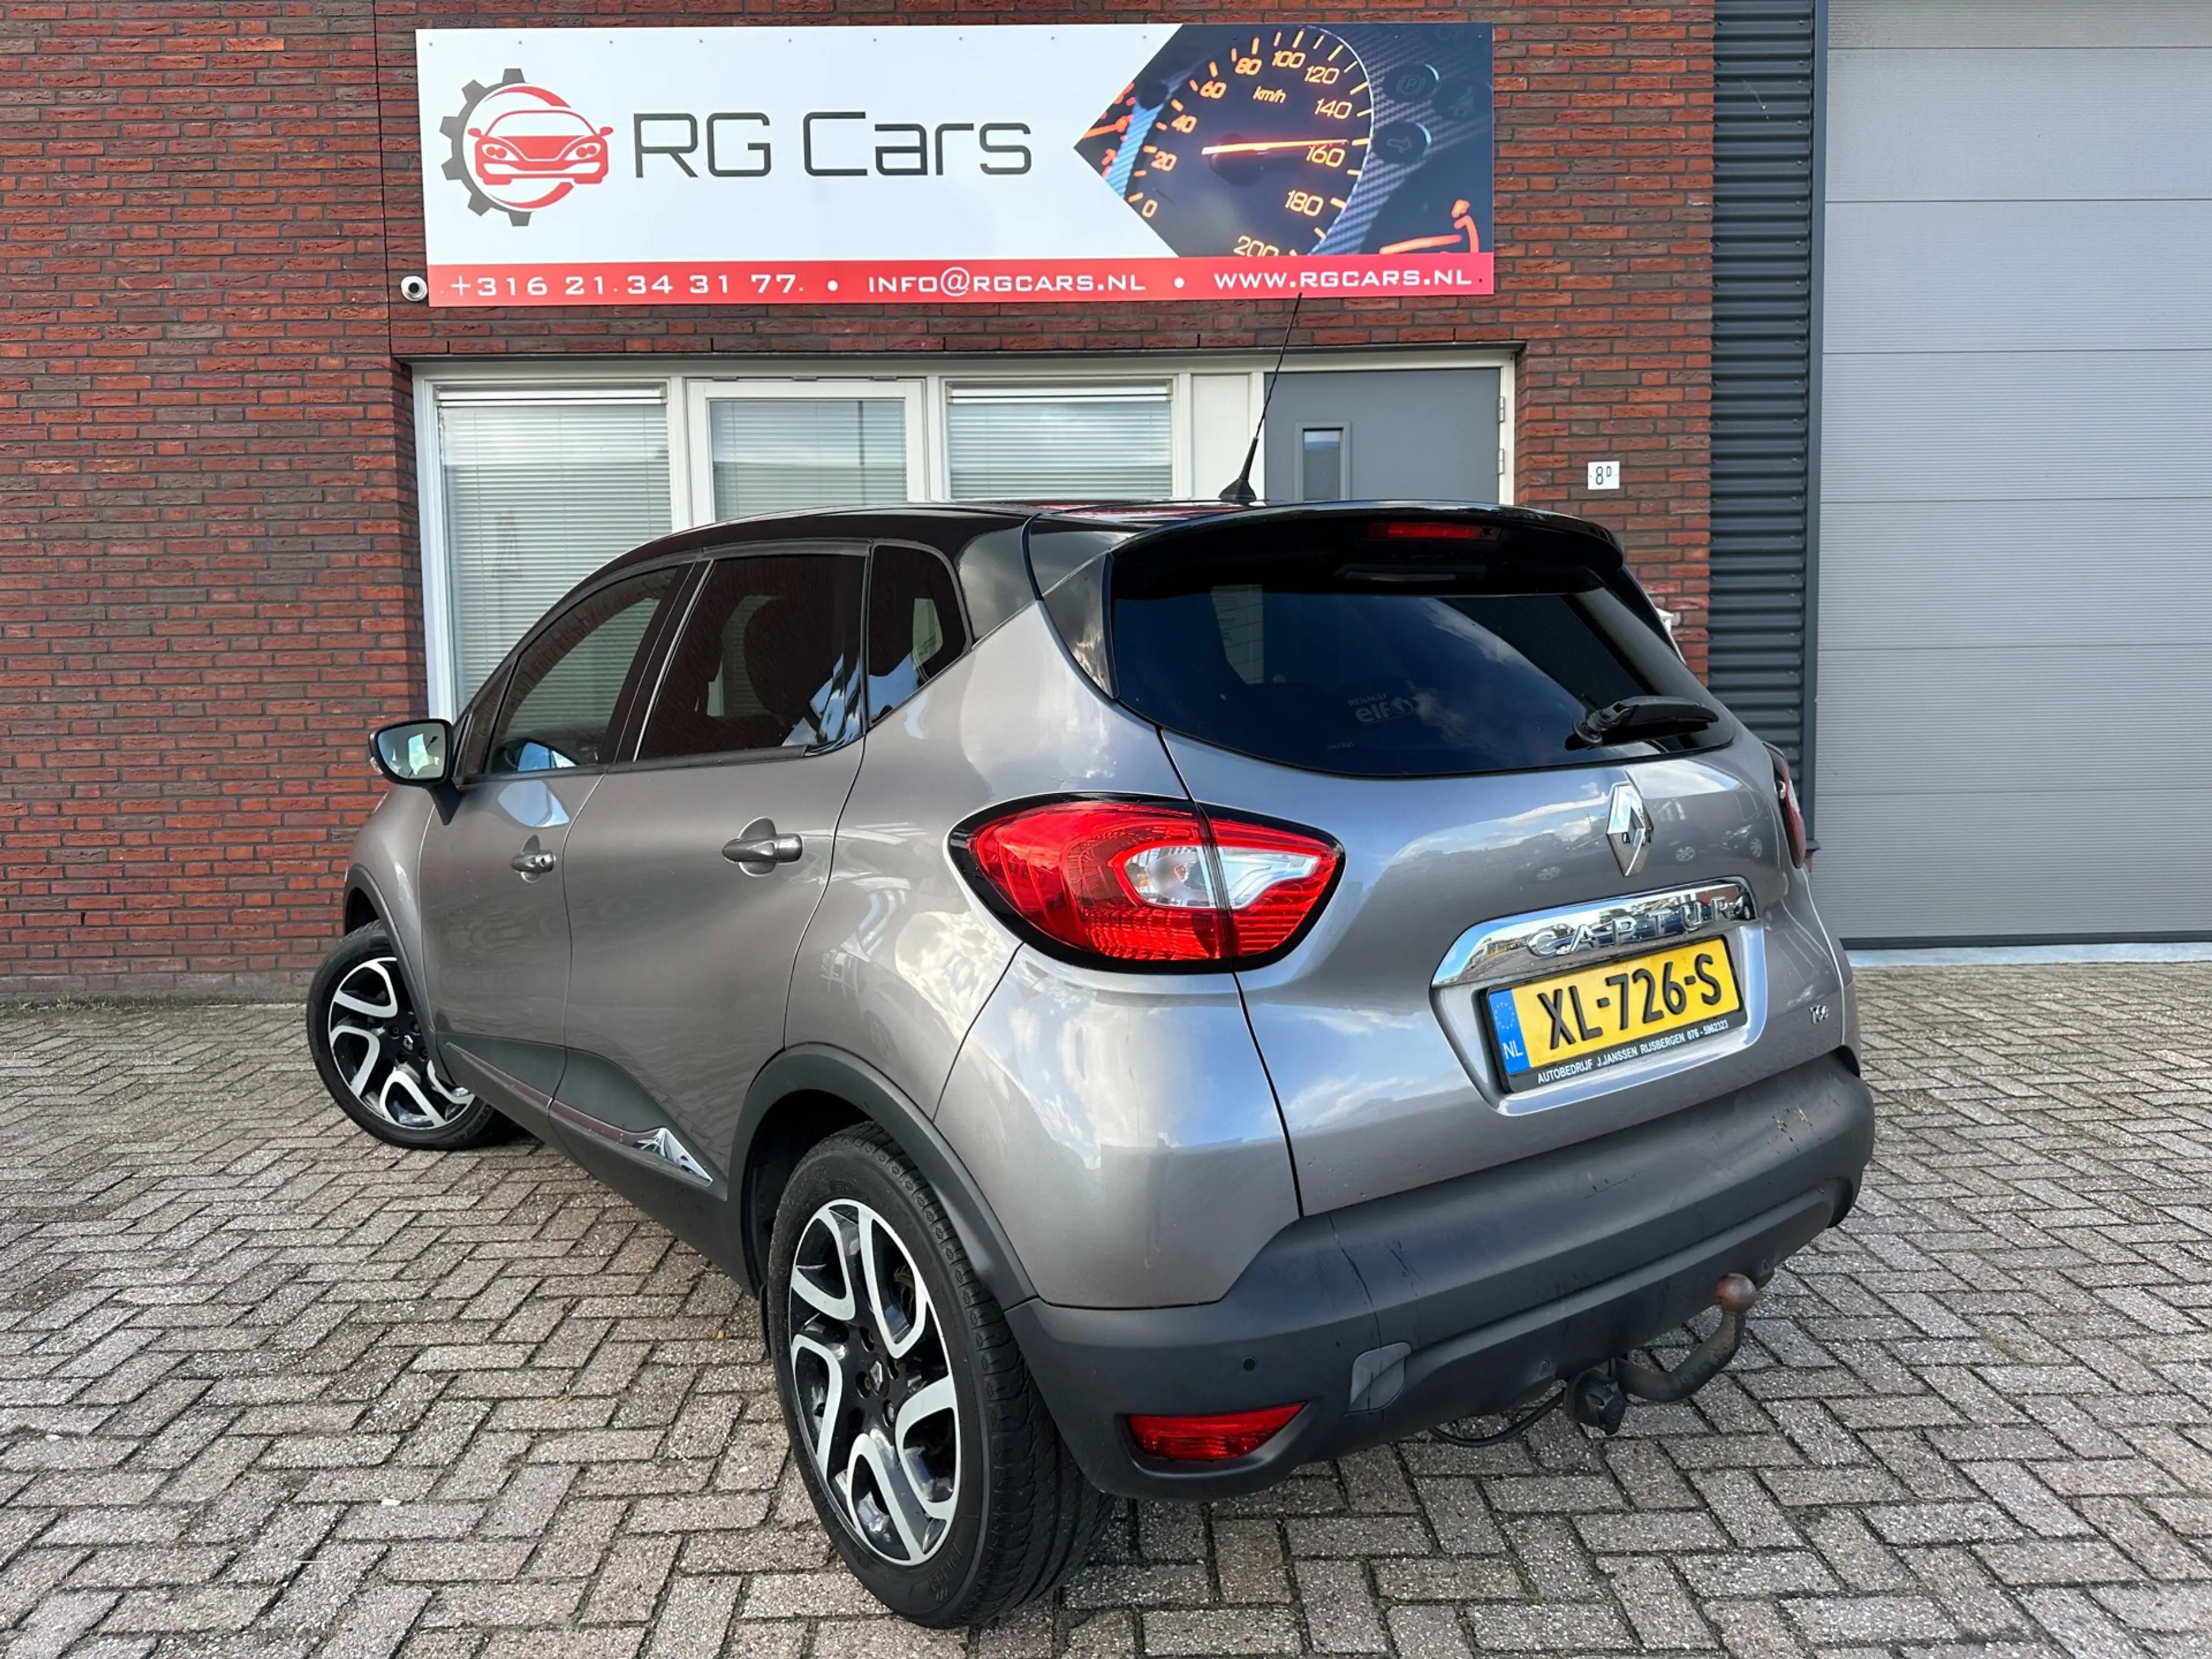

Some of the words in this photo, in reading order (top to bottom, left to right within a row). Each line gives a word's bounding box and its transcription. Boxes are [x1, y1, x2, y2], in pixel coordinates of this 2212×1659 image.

[1235, 56, 1262, 75] 80
[1271, 50, 1306, 69] 100
[1304, 65, 1340, 85] 120
[1199, 80, 1227, 99] 60
[1252, 85, 1286, 104] km/h
[1315, 98, 1353, 119] 140
[1171, 114, 1197, 134] 40
[634, 113, 771, 178] RG
[803, 112, 1031, 176] Cars
[1151, 150, 1177, 172] 20
[1306, 145, 1345, 167] 160
[1142, 199, 1158, 218] 0
[1285, 190, 1324, 217] 180
[450, 275, 548, 297] +316
[689, 274, 728, 294] 31
[869, 266, 1146, 297] INFO@RGCARS.NL
[1214, 269, 1472, 289] WWW.RGCARS.NL
[1355, 701, 1391, 722] elf
[1525, 895, 1730, 957] CAPTUR
[1537, 953, 1722, 1051] XL-726-S
[1502, 1041, 1524, 1059] NL
[1537, 1059, 1593, 1085] AUTOBEDRIJF
[1687, 1028, 1699, 1040] 076
